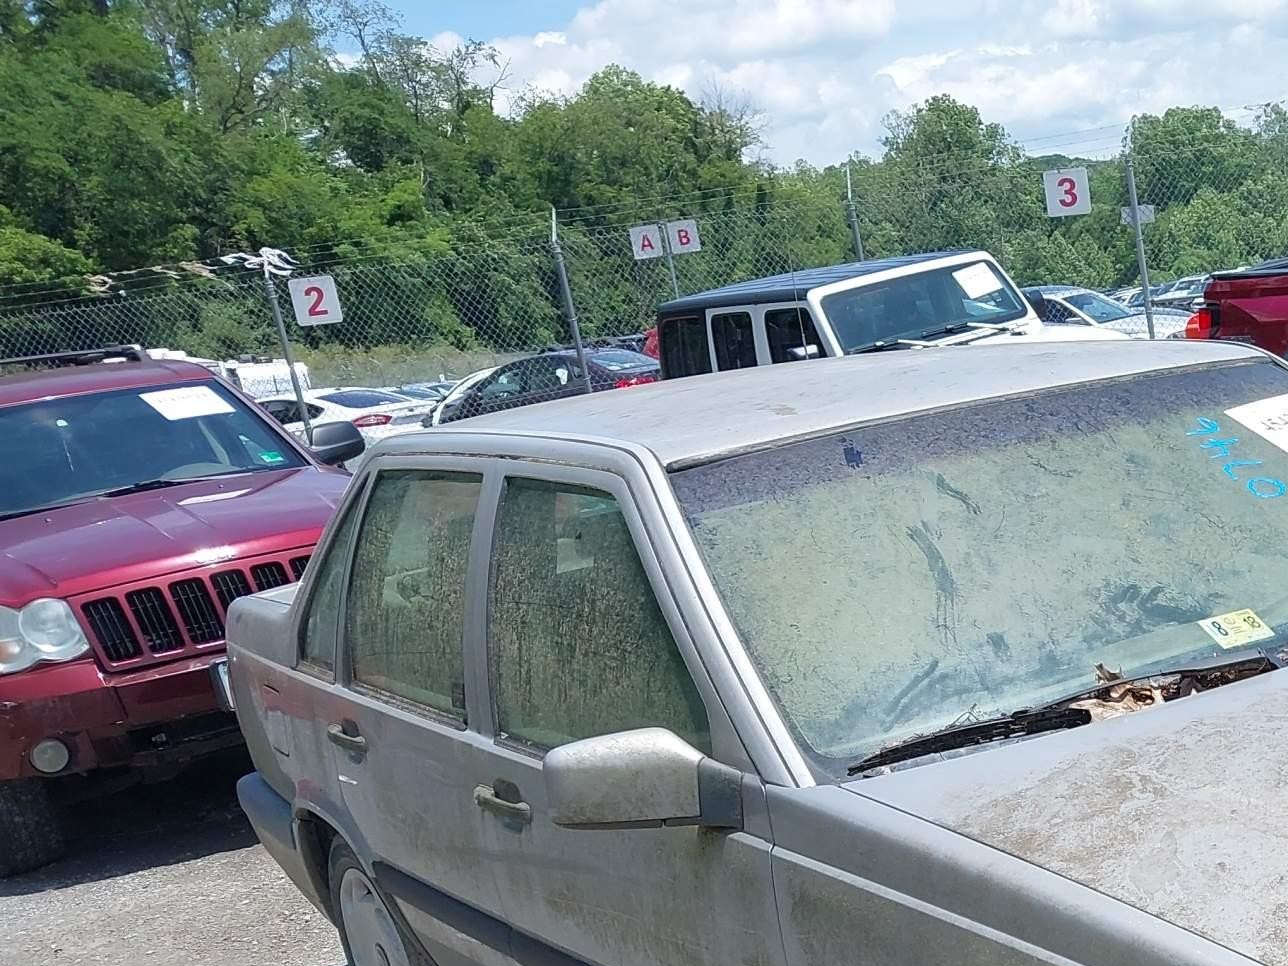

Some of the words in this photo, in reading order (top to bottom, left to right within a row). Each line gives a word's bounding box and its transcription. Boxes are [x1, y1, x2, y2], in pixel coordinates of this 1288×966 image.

[1057, 177, 1078, 208] 3
[641, 234, 654, 251] A
[677, 229, 690, 245] B
[304, 286, 329, 316] 2
[1211, 621, 1229, 637] 8
